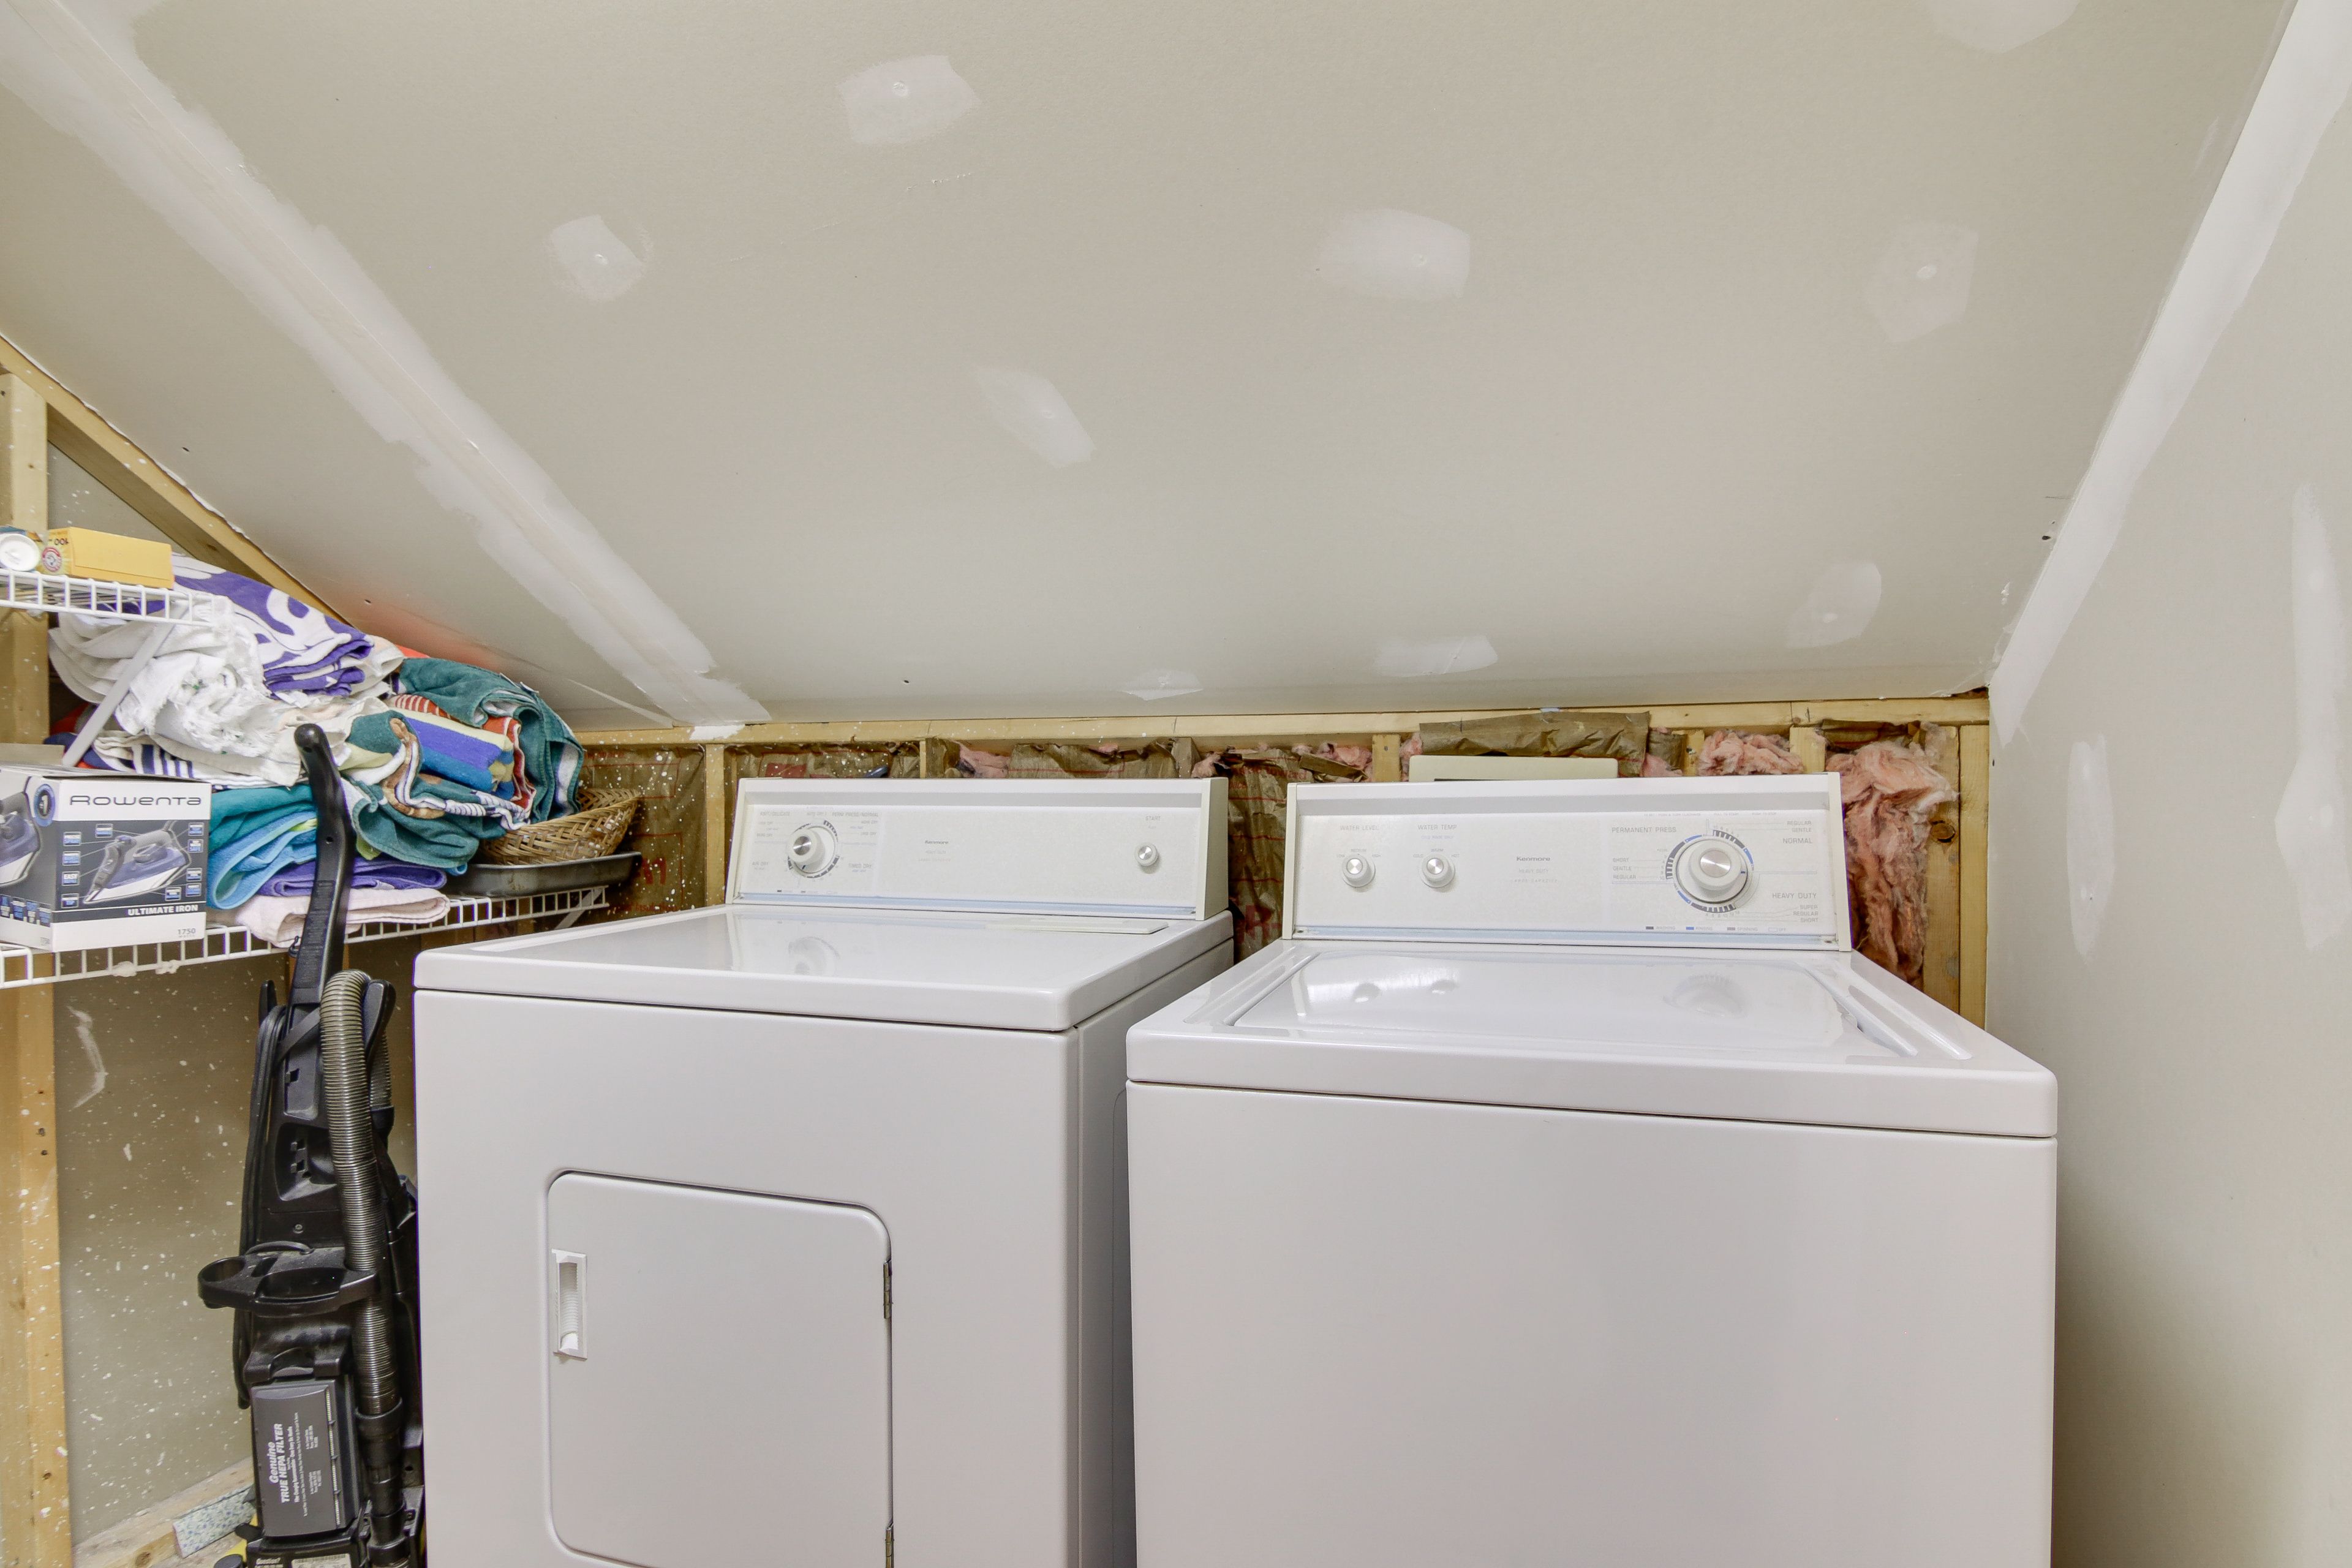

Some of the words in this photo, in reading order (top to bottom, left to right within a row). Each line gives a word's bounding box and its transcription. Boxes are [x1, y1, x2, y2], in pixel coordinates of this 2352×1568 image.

[127, 907, 175, 916] ULTIMATE
[274, 1423, 284, 1453] FILTER
[268, 1442, 279, 1483] Genuine
[277, 1455, 287, 1478] HEPA
[280, 1479, 290, 1504] TRUE
